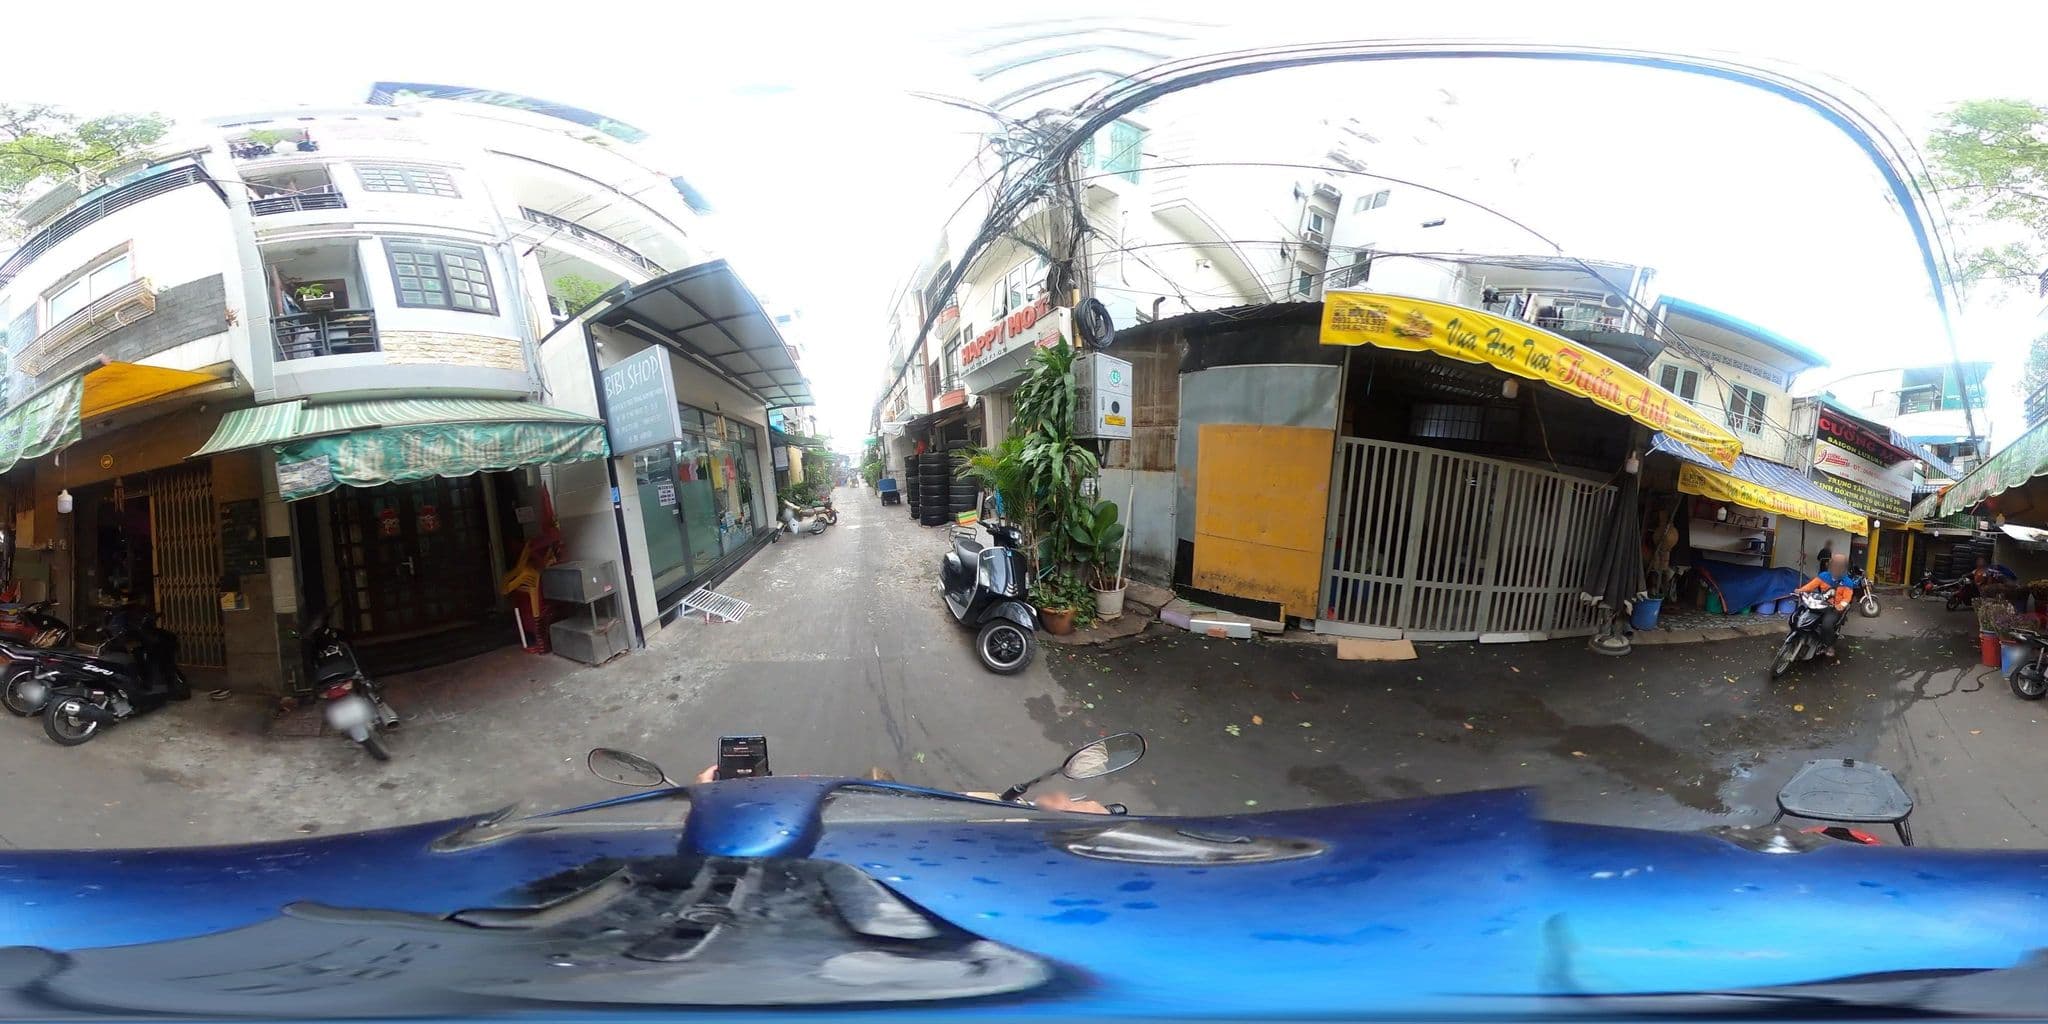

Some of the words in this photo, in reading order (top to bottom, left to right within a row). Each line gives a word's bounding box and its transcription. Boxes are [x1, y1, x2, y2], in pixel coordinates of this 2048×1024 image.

[961, 320, 1005, 366] HAPPY
[604, 369, 626, 400] BIBI
[627, 355, 659, 390] SHOP
[1486, 327, 1516, 360] Hoa
[1625, 385, 1670, 428] Anh
[1827, 436, 1857, 454] SAIGON
